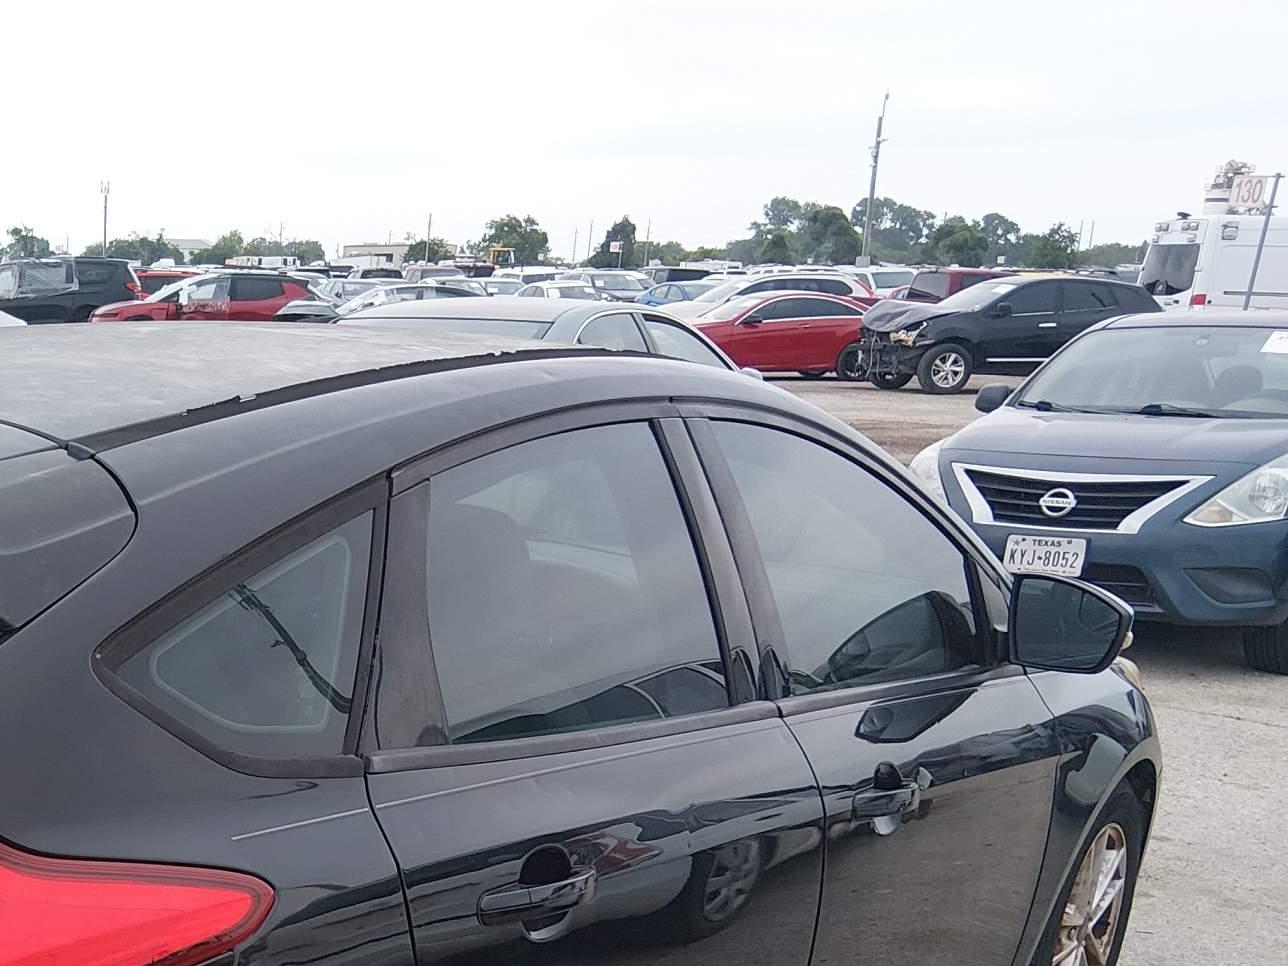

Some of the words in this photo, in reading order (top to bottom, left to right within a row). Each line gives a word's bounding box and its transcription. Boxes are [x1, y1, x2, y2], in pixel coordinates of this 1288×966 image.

[1235, 179, 1263, 203] 130
[1041, 498, 1073, 506] NISSAN
[1032, 539, 1062, 548] TEXAS
